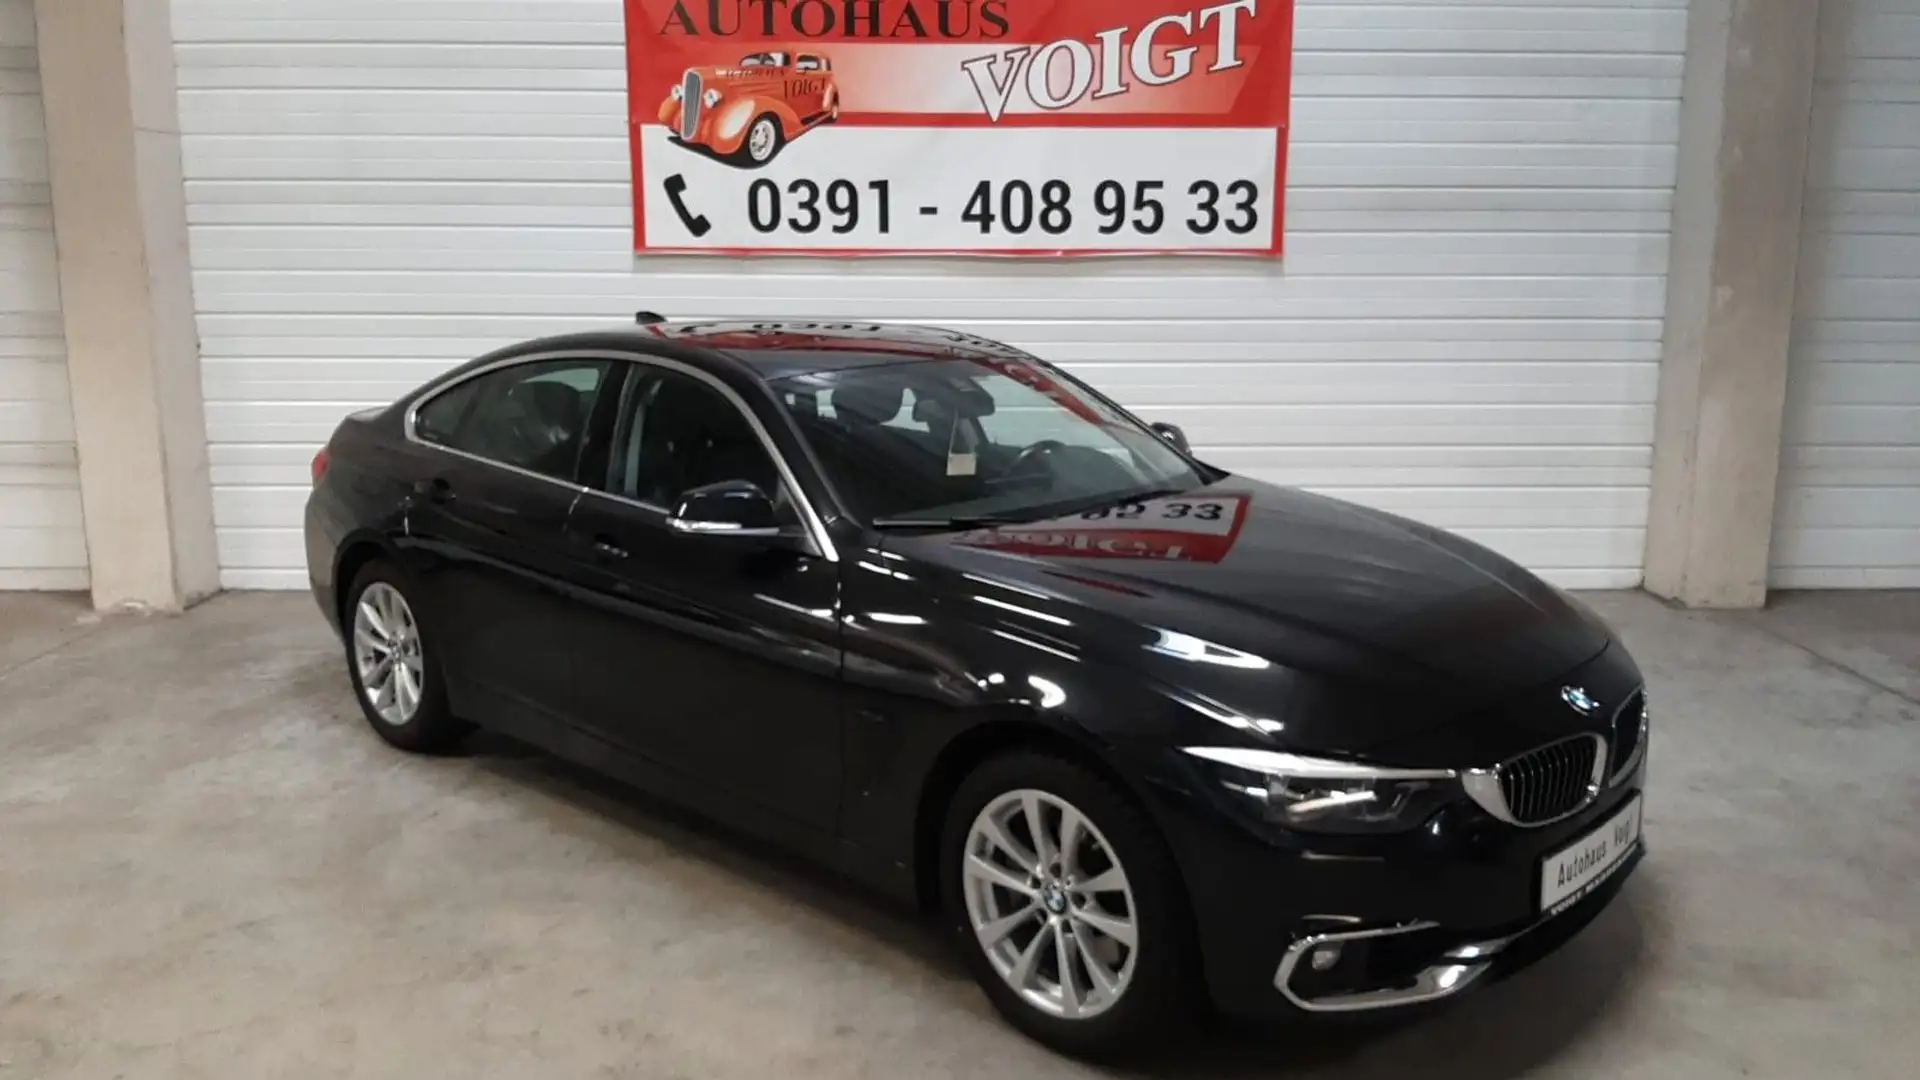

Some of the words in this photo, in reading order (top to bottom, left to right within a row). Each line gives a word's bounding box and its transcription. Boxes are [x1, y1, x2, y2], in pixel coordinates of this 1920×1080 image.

[659, 0, 1010, 38] AUTOHAUS
[961, 0, 1257, 123] VOIGT
[747, 178, 890, 235] 0391
[918, 205, 938, 216] -
[960, 178, 1073, 235] 408
[1094, 178, 1165, 235] 95
[1186, 178, 1259, 235] 33
